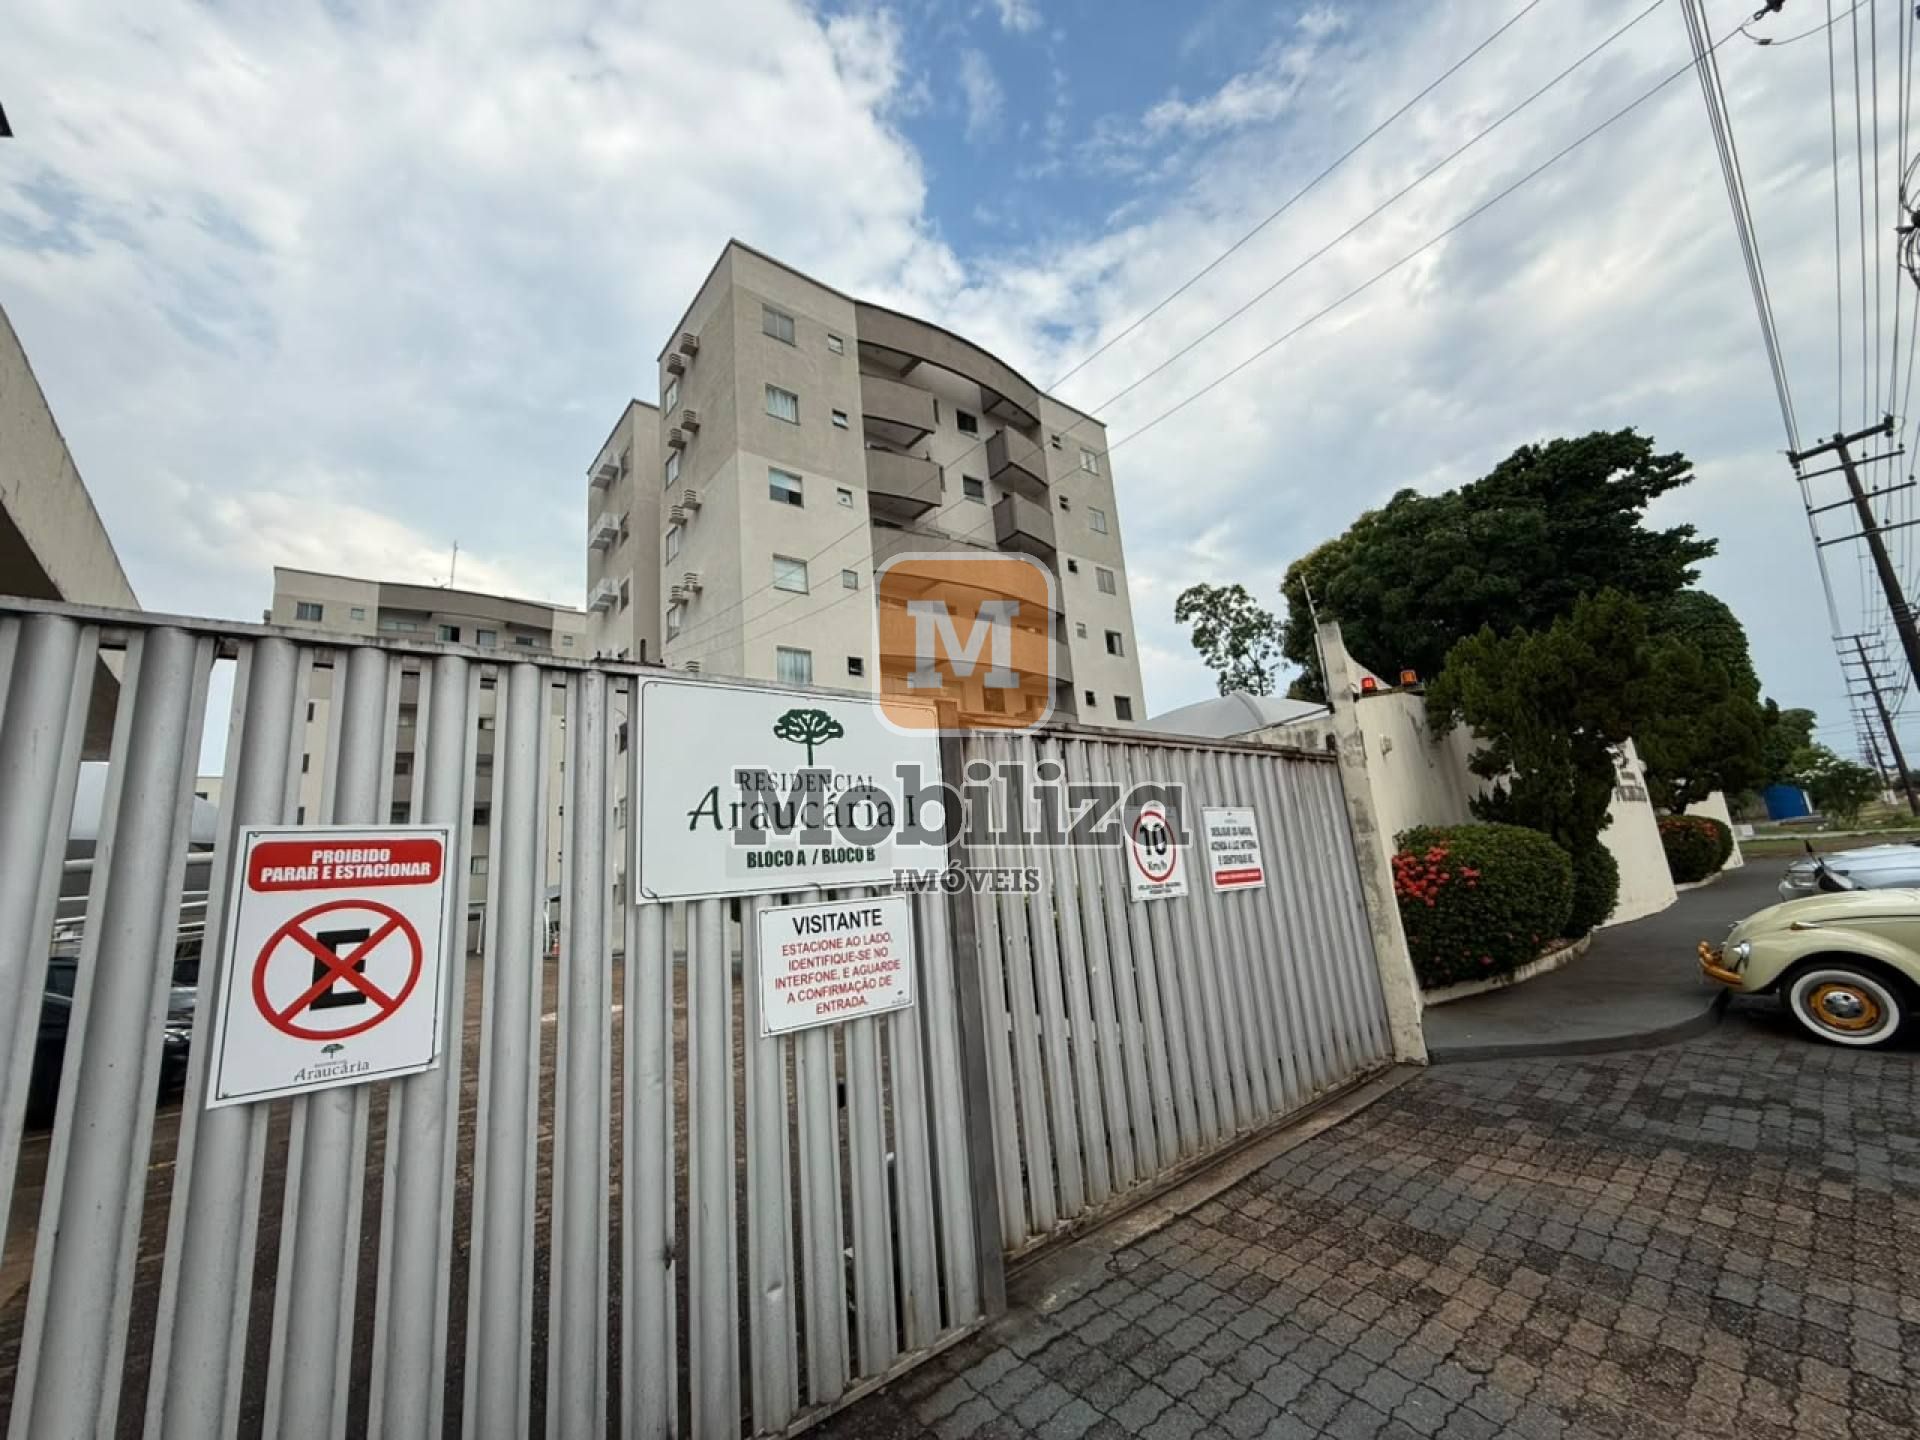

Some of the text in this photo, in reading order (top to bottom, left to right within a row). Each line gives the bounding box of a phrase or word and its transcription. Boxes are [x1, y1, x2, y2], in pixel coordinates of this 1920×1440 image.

[738, 771, 878, 793] RESIDENCIAL
[687, 786, 895, 831] Araucária
[1139, 823, 1167, 855] 10
[311, 849, 391, 865] PROIBIDO
[746, 850, 796, 869] BLOCO
[796, 851, 807, 866] A
[821, 848, 864, 865] BLOCO
[866, 847, 876, 862] B
[260, 862, 431, 883] PARAR E ESTACIONAR
[792, 908, 883, 936] VISITANTE
[782, 938, 843, 957] ESTACIONE
[845, 935, 861, 950] AO
[789, 947, 889, 972] IDENTIFIQUE-SE NO
[843, 967, 850, 979] E
[852, 959, 901, 976] AGUARDE
[787, 975, 893, 1004] A CONFIRMAÇÃO DE
[293, 1060, 370, 1082] Araucária
